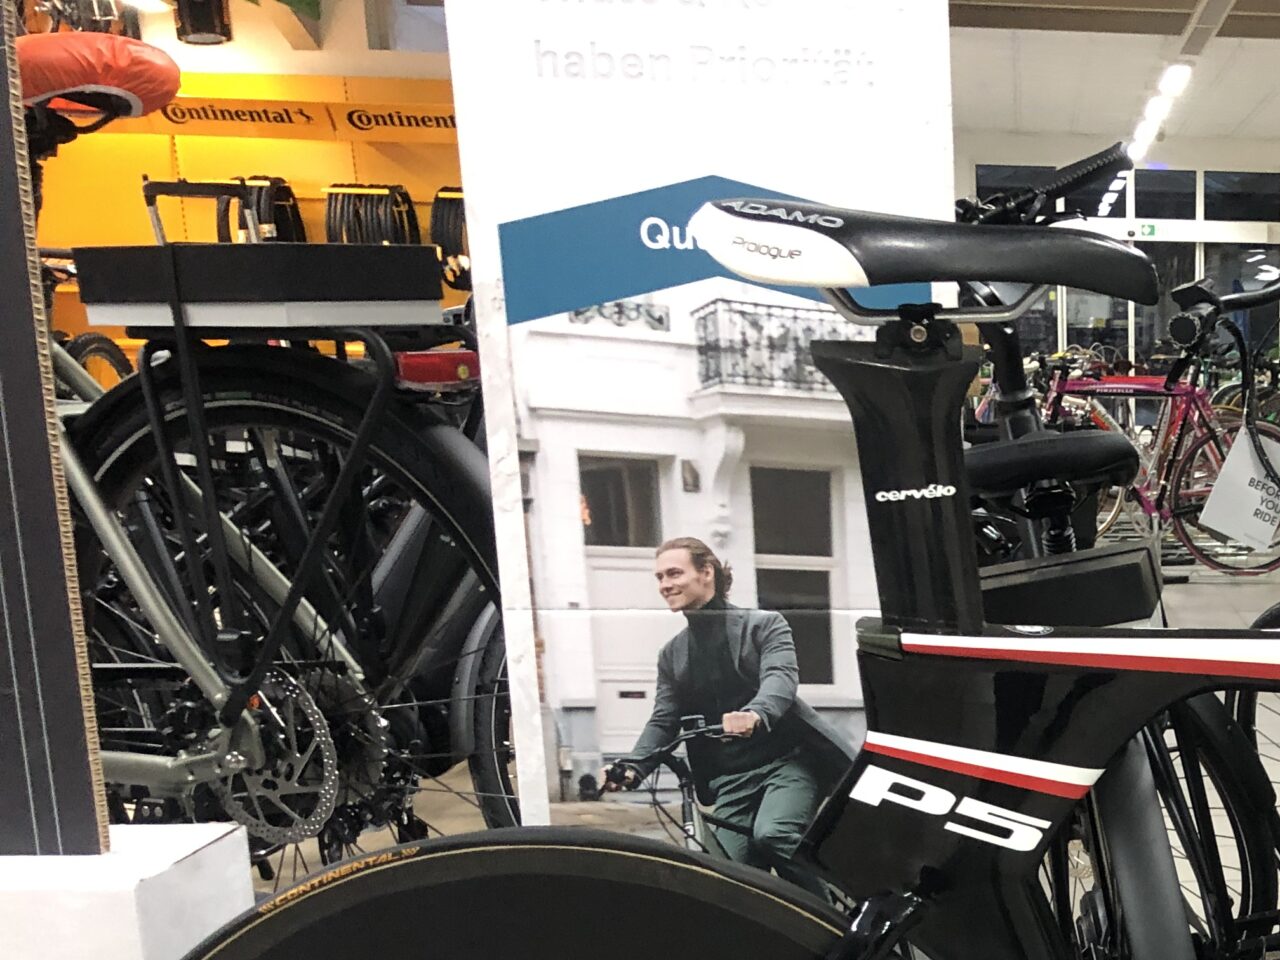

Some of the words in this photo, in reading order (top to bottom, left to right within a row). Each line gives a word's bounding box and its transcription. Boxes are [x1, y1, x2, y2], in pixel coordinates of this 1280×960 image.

[533, 39, 672, 80] haben
[161, 103, 294, 124] Continental
[720, 201, 845, 228] ADAMO
[732, 236, 802, 259] Prologue
[1253, 508, 1278, 526] RIDE
[849, 763, 1051, 852] P5
[275, 852, 399, 906] CONTINENTAL
